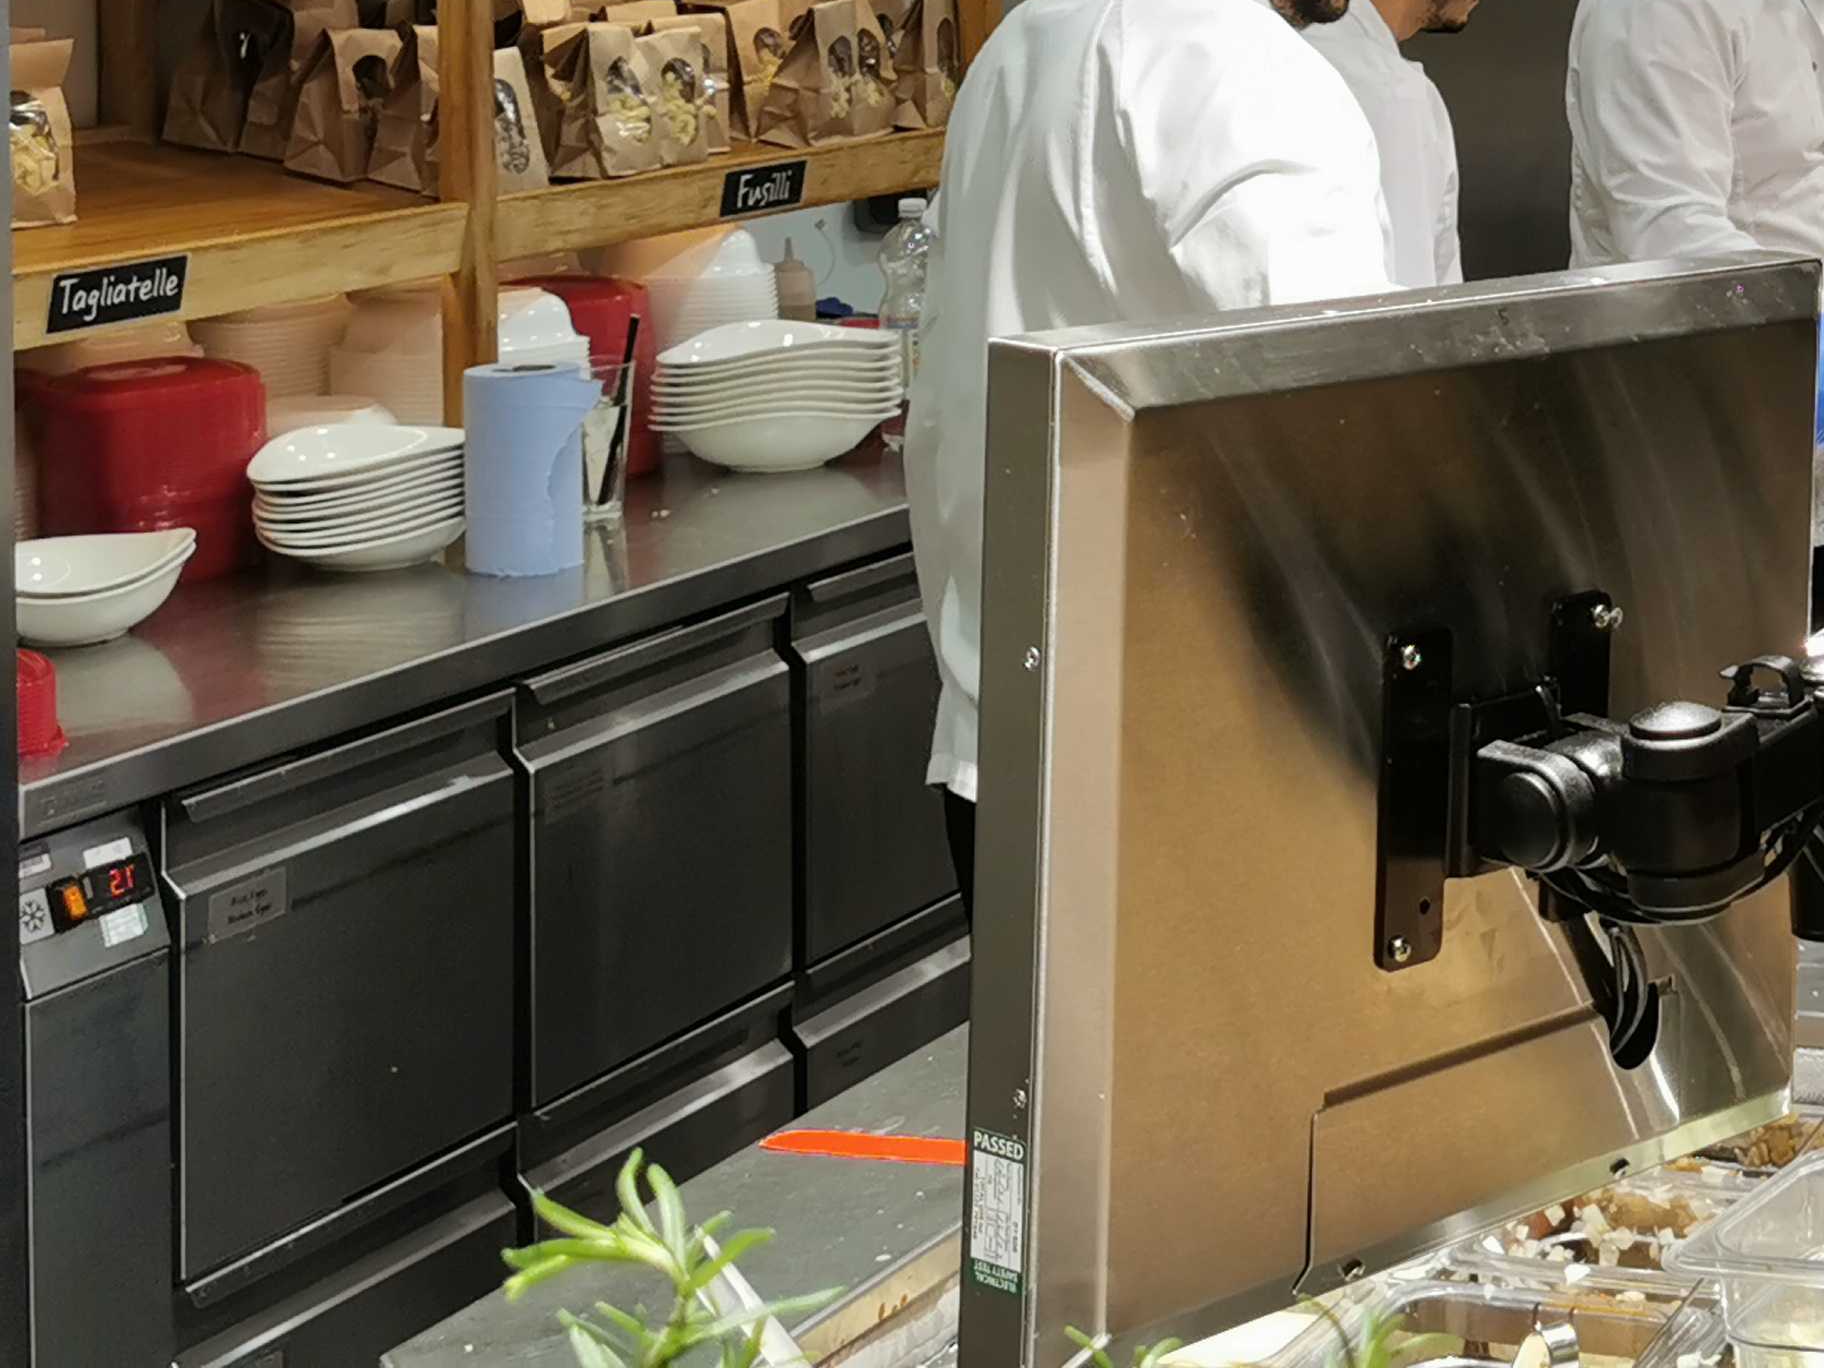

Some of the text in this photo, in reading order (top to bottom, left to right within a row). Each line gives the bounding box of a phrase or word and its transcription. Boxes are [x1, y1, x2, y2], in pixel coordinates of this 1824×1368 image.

[737, 170, 792, 209] Fusilli
[59, 268, 178, 322] Tagliatelle
[974, 1131, 1024, 1161] PASSED
